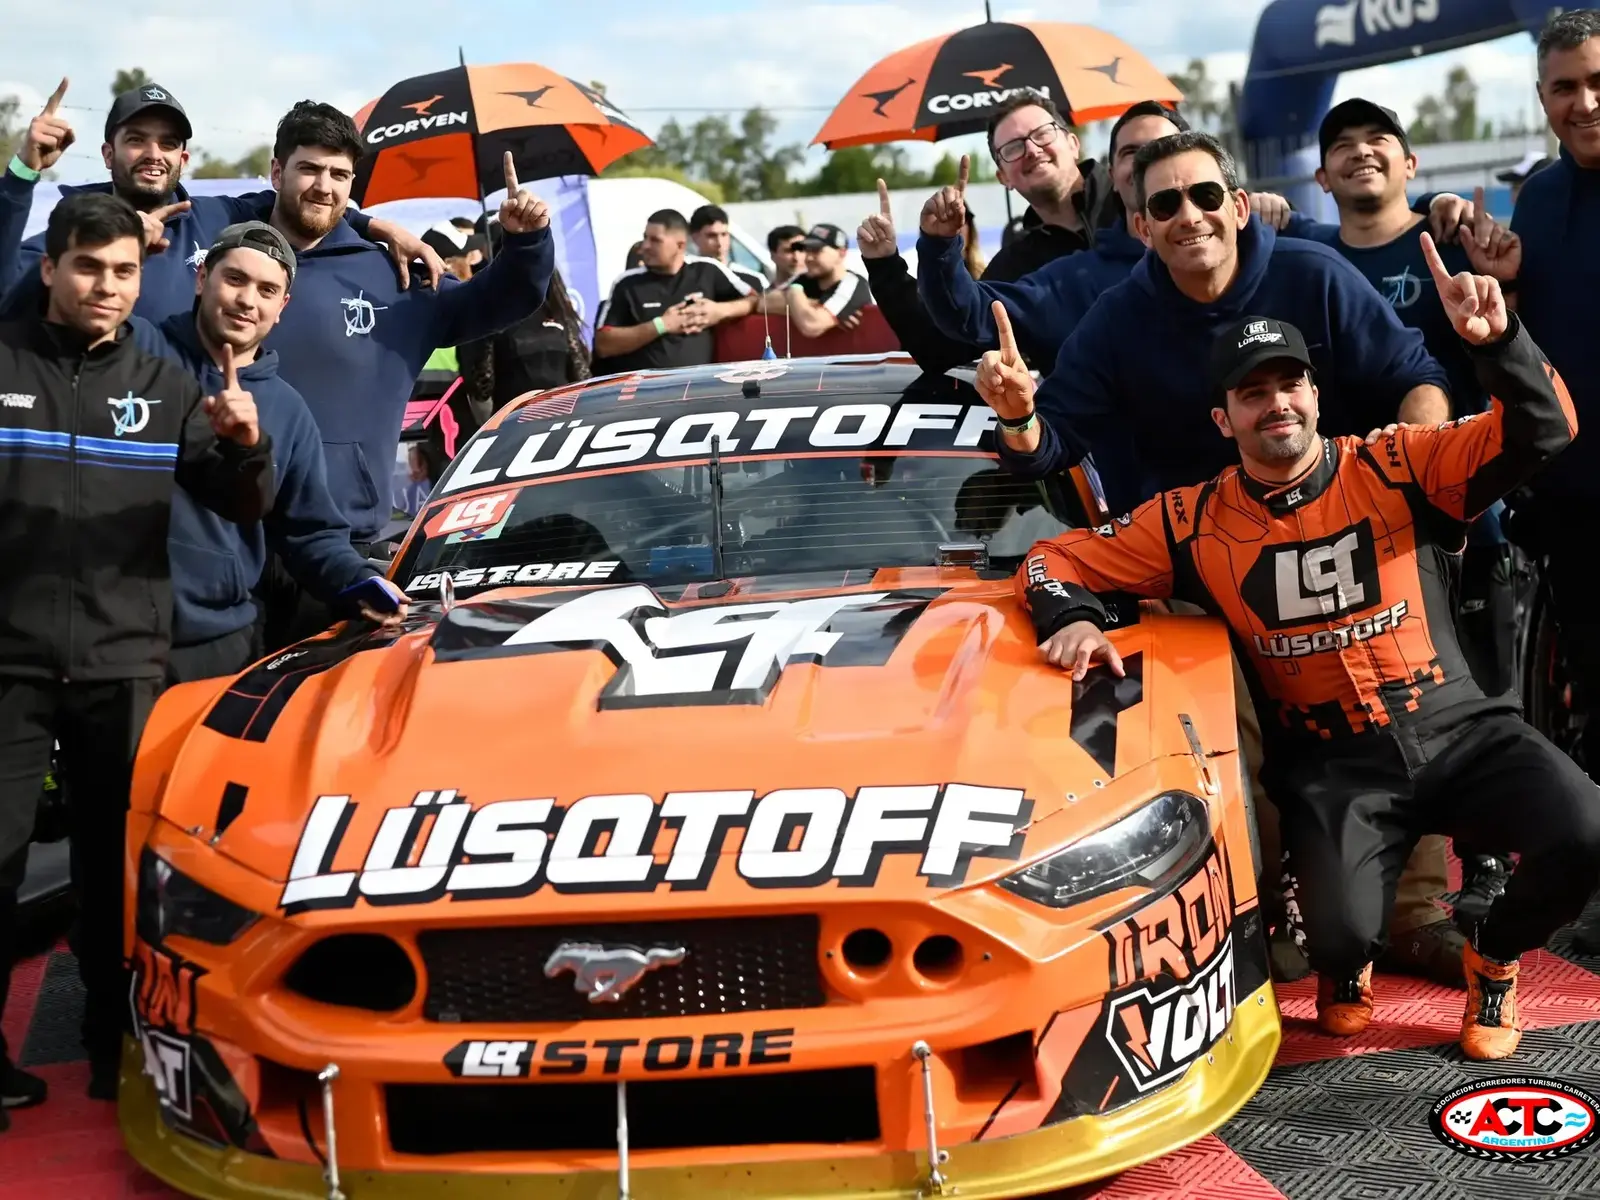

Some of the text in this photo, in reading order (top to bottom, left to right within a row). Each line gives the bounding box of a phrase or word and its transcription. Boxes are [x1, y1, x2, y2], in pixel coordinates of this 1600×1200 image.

[927, 85, 1050, 114] CORVN
[366, 111, 468, 144] CORVEN
[1171, 491, 1188, 524] HRX
[452, 561, 621, 589] STORE
[1254, 600, 1408, 657] LÜSQTOFF
[278, 783, 1033, 914] LÜSQTOFF
[1107, 853, 1233, 983] IRON
[1119, 948, 1233, 1078] VOLT
[539, 1028, 794, 1075] STORE
